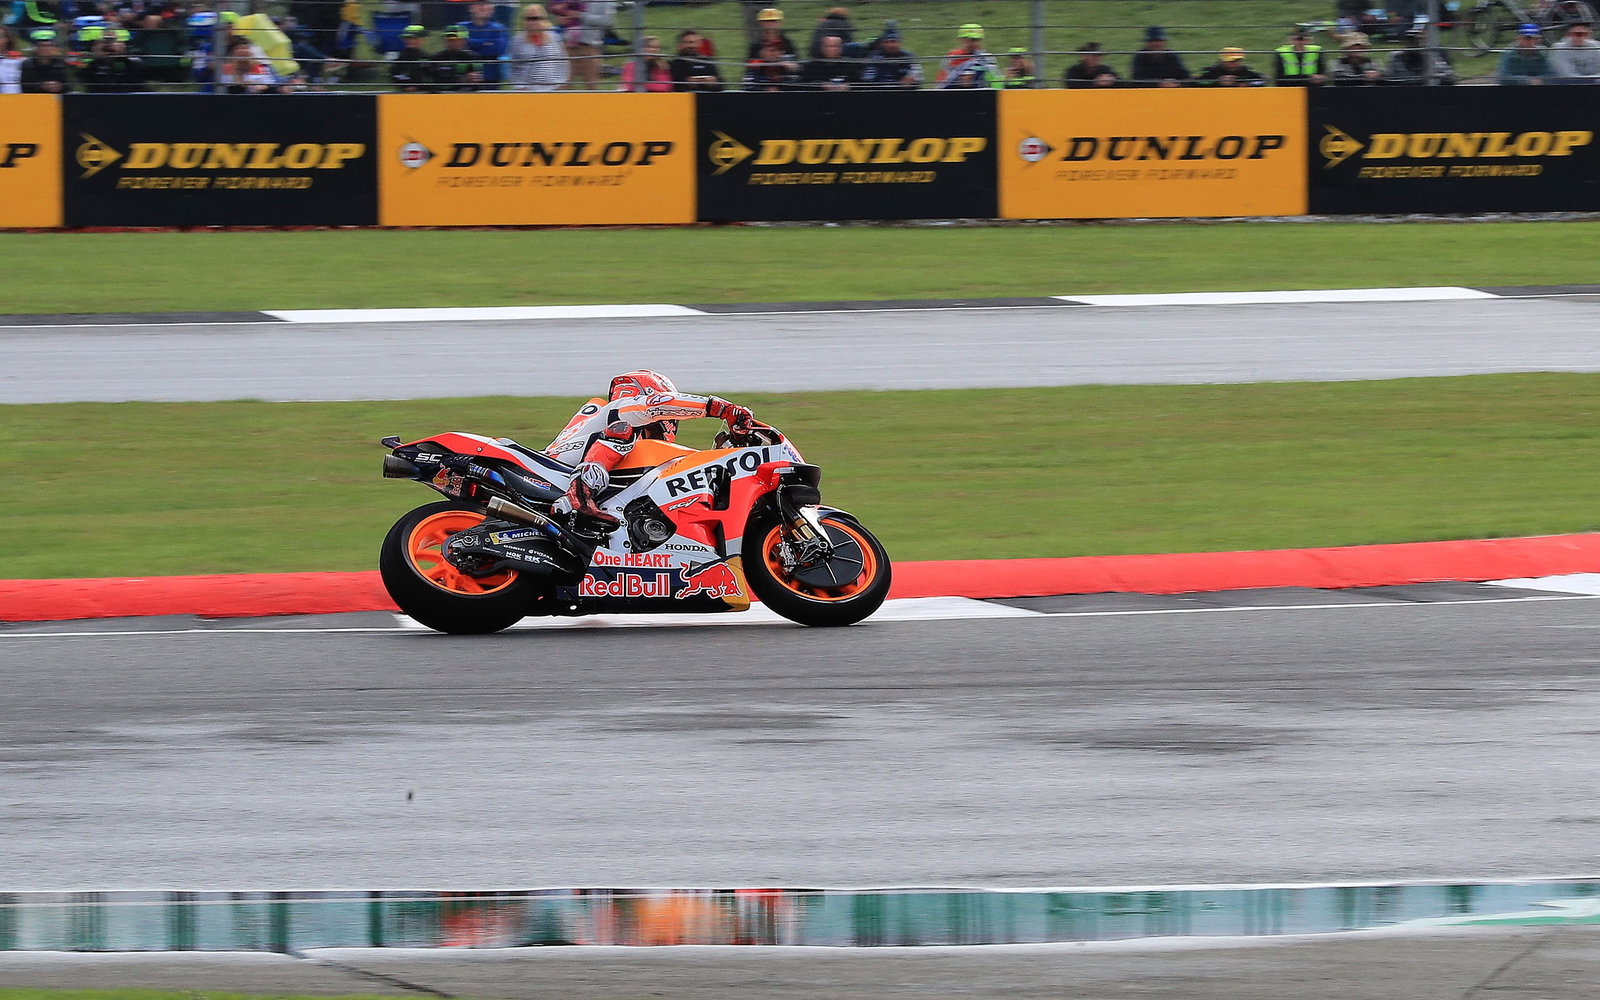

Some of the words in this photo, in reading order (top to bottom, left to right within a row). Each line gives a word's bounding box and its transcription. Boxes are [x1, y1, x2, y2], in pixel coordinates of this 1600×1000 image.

[121, 142, 366, 169] DUNLOP
[443, 141, 675, 167] DUNLOP
[752, 137, 987, 165] DUNLOP
[1061, 135, 1287, 162] DUNLOP
[1362, 130, 1593, 159] DUNLOP
[511, 531, 546, 539] MICHEL
[665, 543, 709, 553] HONDA
[593, 551, 621, 566] One
[578, 573, 624, 597] Red
[626, 573, 671, 597] Bull
